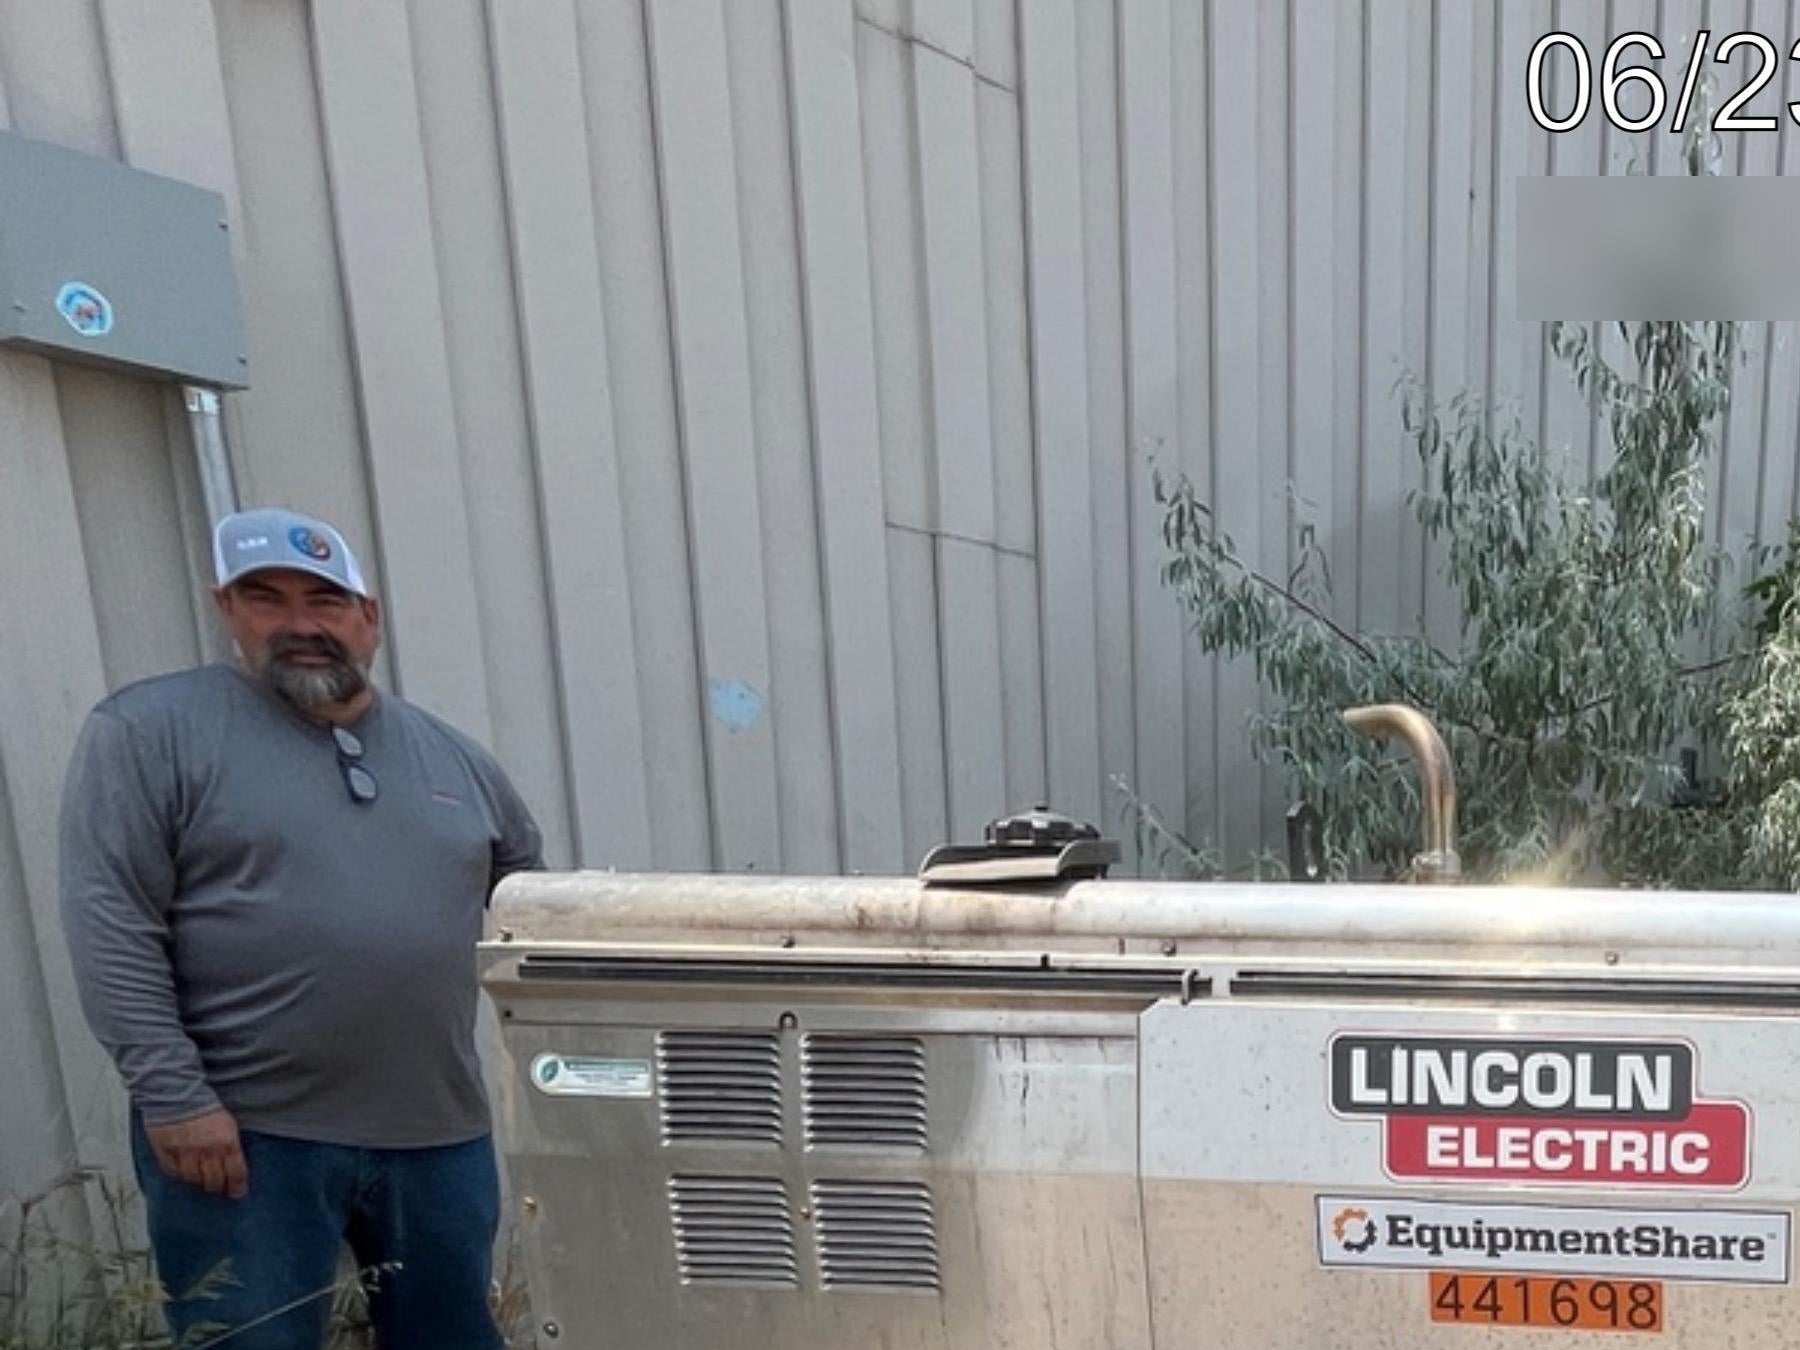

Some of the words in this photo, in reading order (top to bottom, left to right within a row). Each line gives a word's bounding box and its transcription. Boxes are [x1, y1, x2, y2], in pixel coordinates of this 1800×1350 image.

[1350, 1046, 1673, 1110] LINCOLN
[1426, 1125, 1711, 1175] ELECTRIC
[1386, 1214, 1765, 1262] EquipmentShare
[1435, 1276, 1658, 1329] 441698
